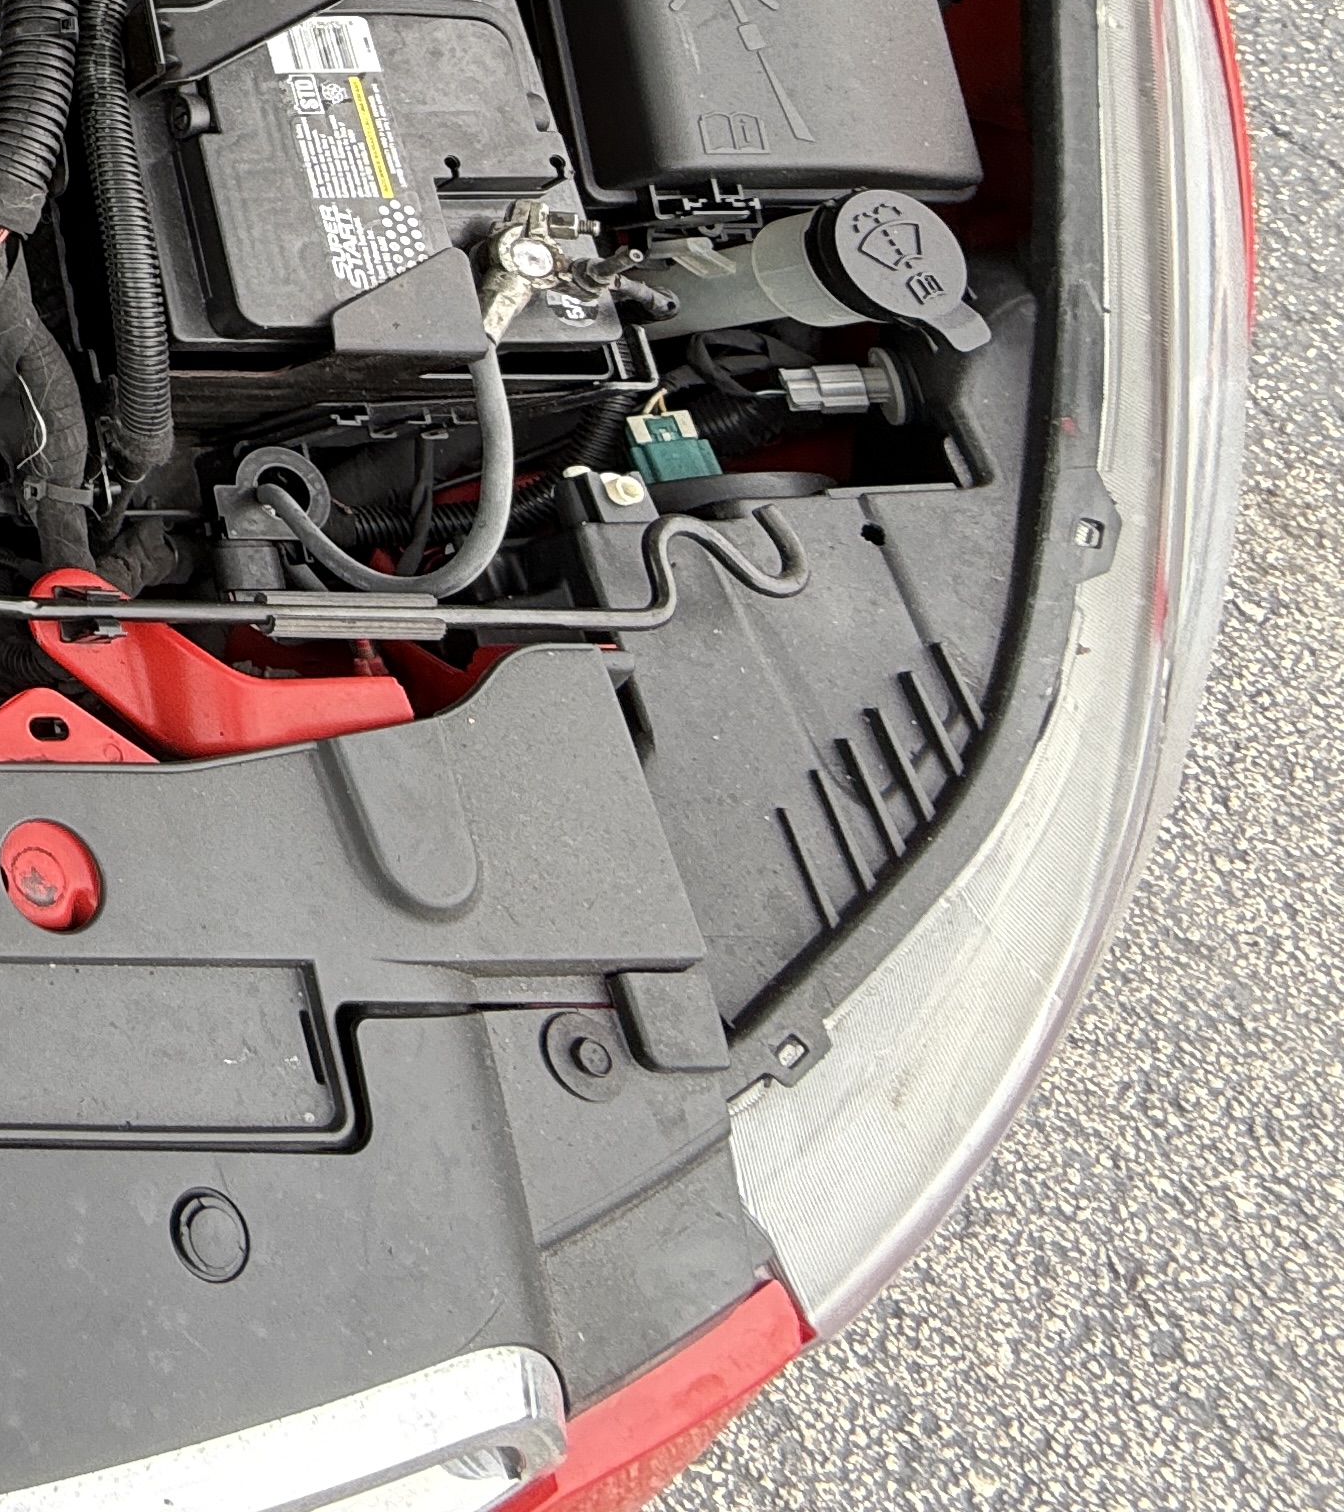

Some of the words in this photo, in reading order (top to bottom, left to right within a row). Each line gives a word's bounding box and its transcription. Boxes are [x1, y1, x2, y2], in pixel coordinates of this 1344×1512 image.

[297, 81, 320, 110] STD
[319, 205, 347, 278] SUPER
[332, 205, 369, 290] START
